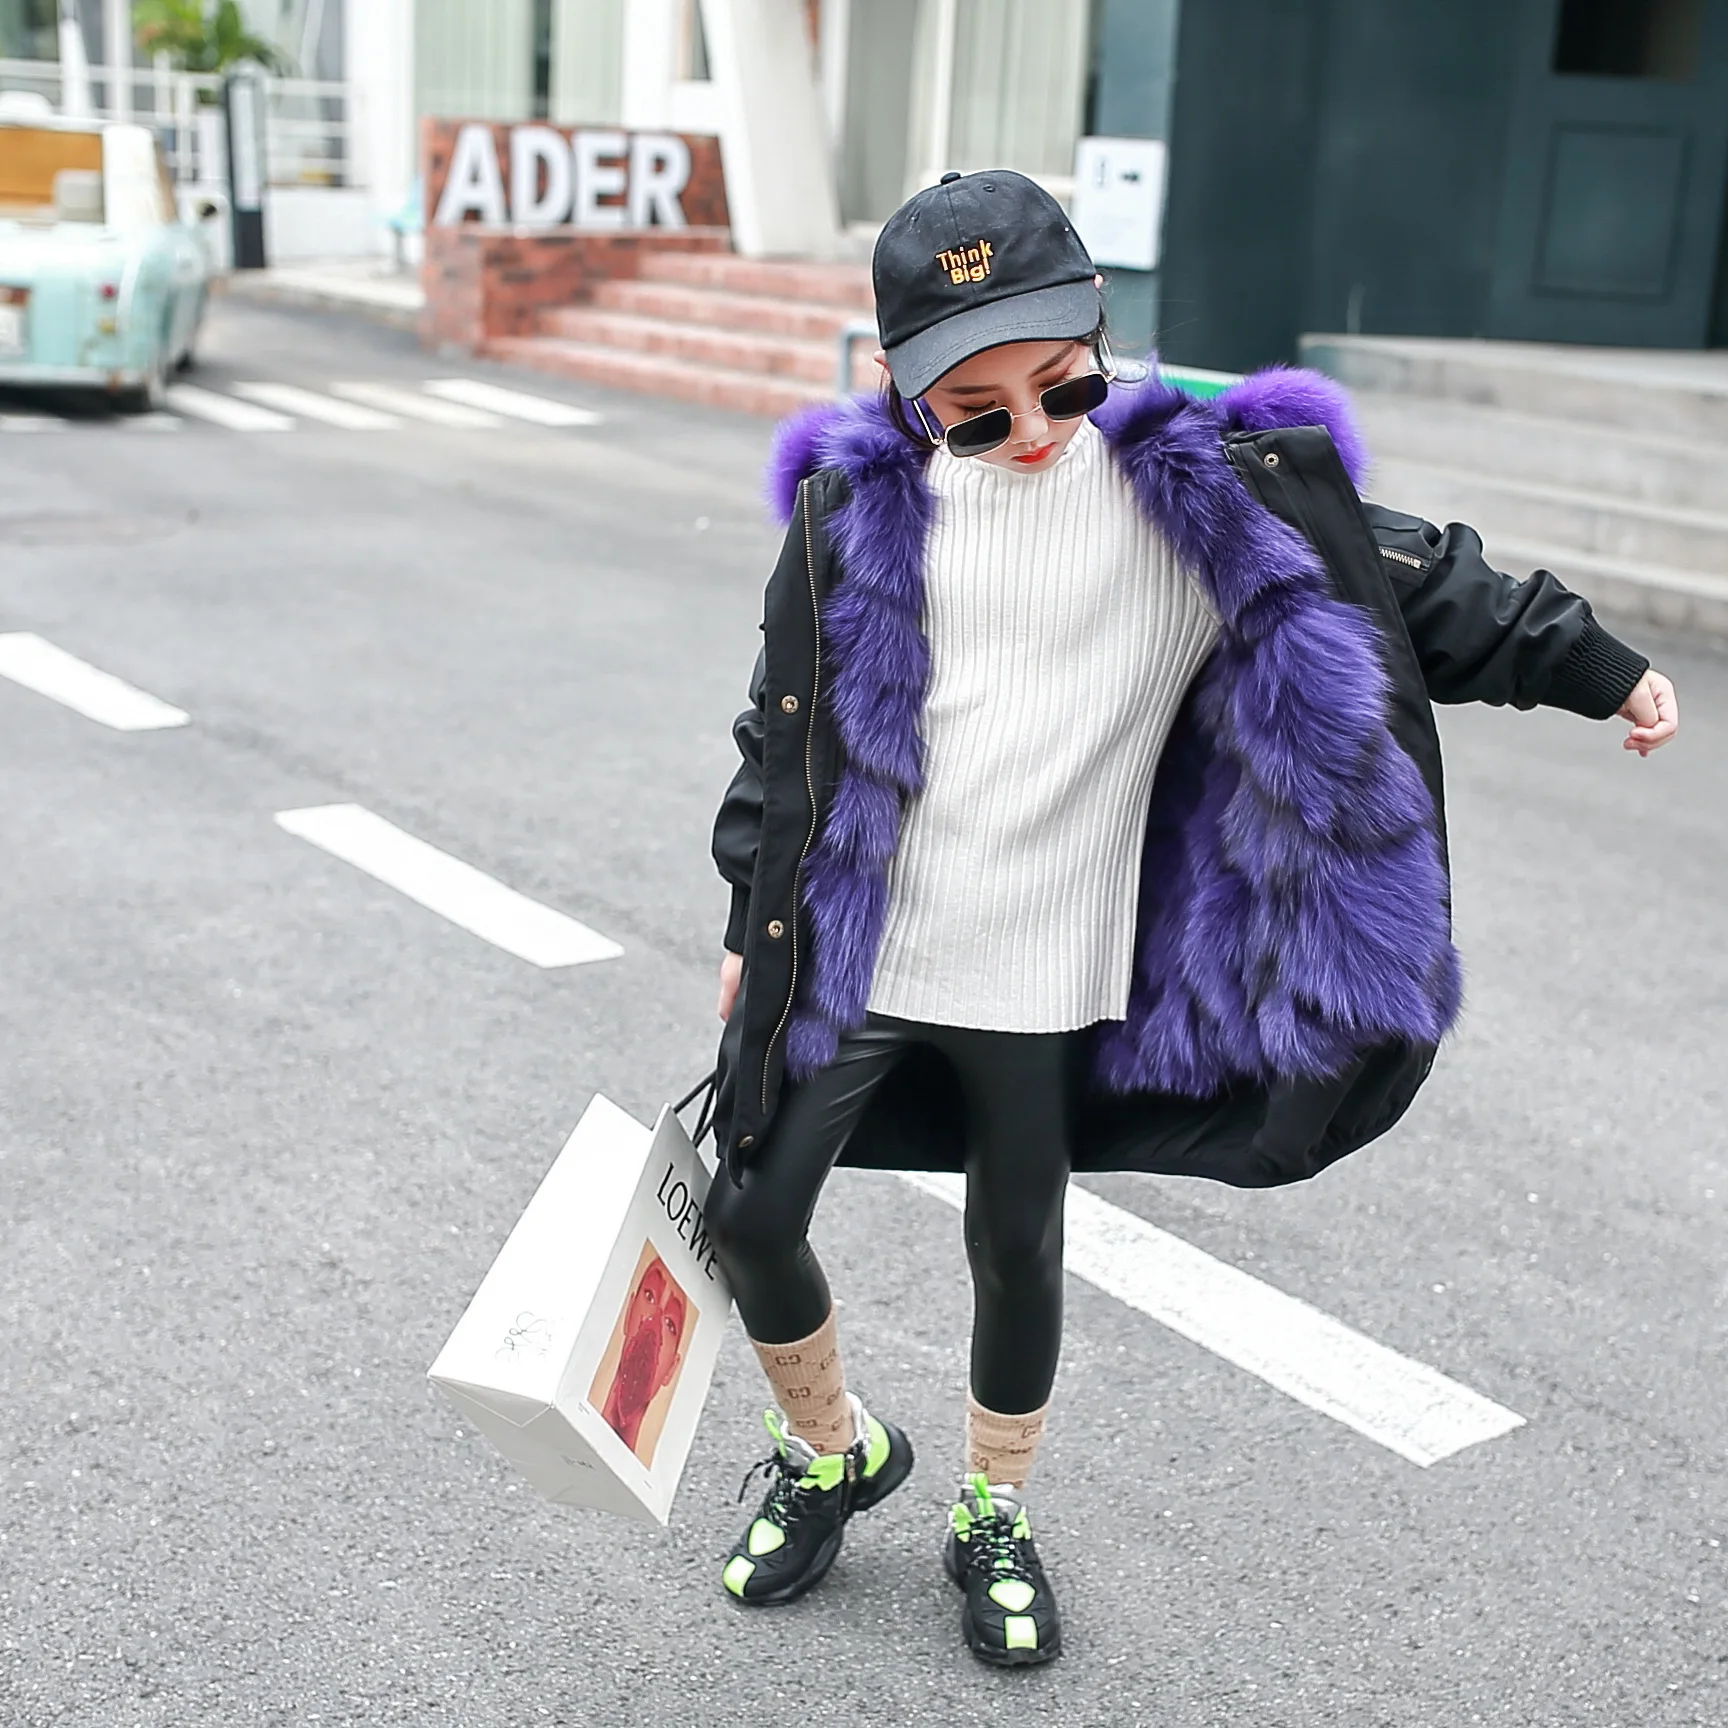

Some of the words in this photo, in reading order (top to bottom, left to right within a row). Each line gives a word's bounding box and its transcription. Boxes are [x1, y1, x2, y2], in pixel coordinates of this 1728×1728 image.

[434, 124, 691, 230] ADER
[935, 239, 994, 271] Think
[950, 257, 991, 285] Big!
[656, 1161, 718, 1281] LOEWE
